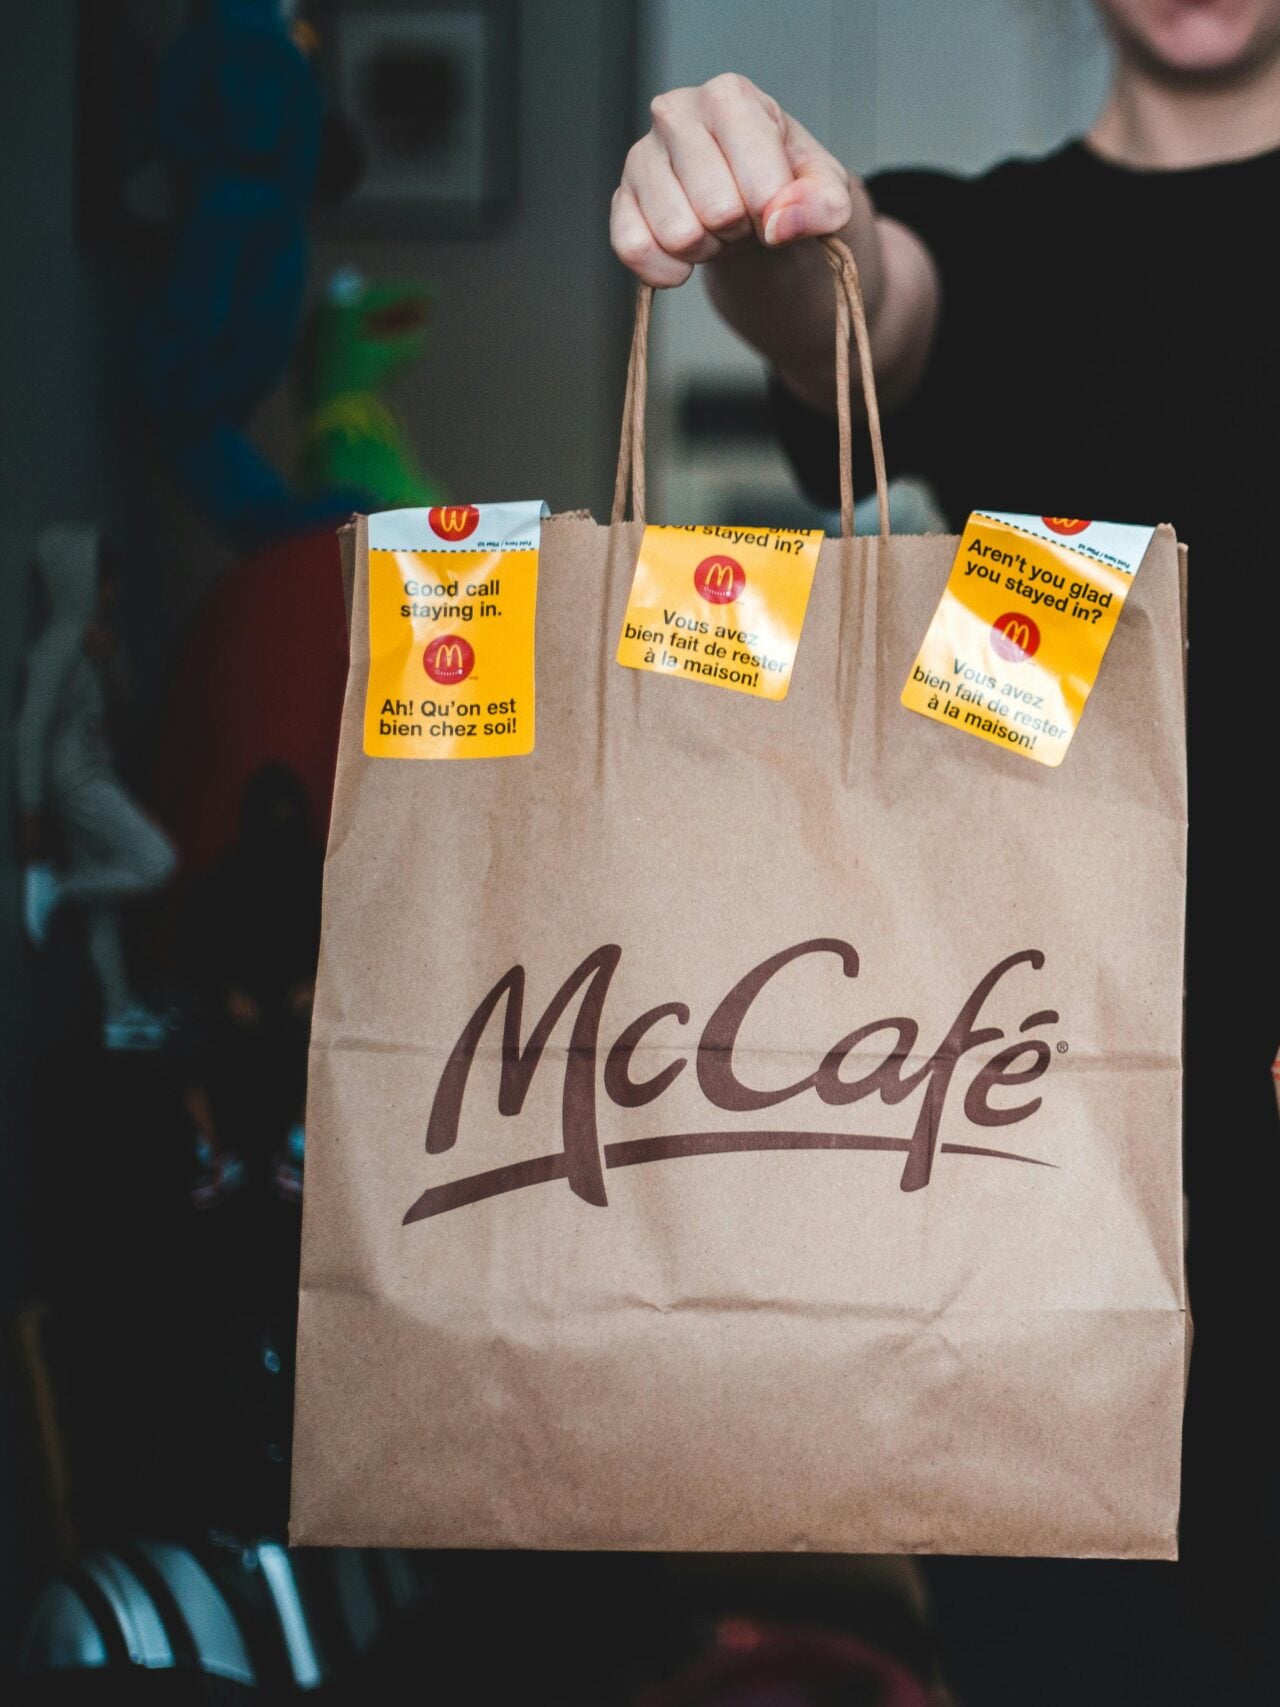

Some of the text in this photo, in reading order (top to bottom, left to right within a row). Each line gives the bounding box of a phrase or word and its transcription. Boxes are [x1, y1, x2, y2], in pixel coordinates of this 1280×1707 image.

[774, 535, 804, 555] in?
[404, 579, 500, 598] Good call
[964, 560, 1103, 625] you stayed in?
[967, 538, 1113, 608] Aren't you glad
[400, 601, 502, 622] staying in.
[663, 609, 759, 646] Vous avez
[625, 623, 788, 674] bien fait de rester
[643, 647, 759, 688] à la maison!
[912, 665, 1070, 740] bien fait de rester
[953, 658, 1044, 711] Vous avez
[379, 717, 517, 737] bien chez soi!
[381, 698, 517, 718] Ah! Qu'on est
[927, 693, 1037, 750] à la maison!
